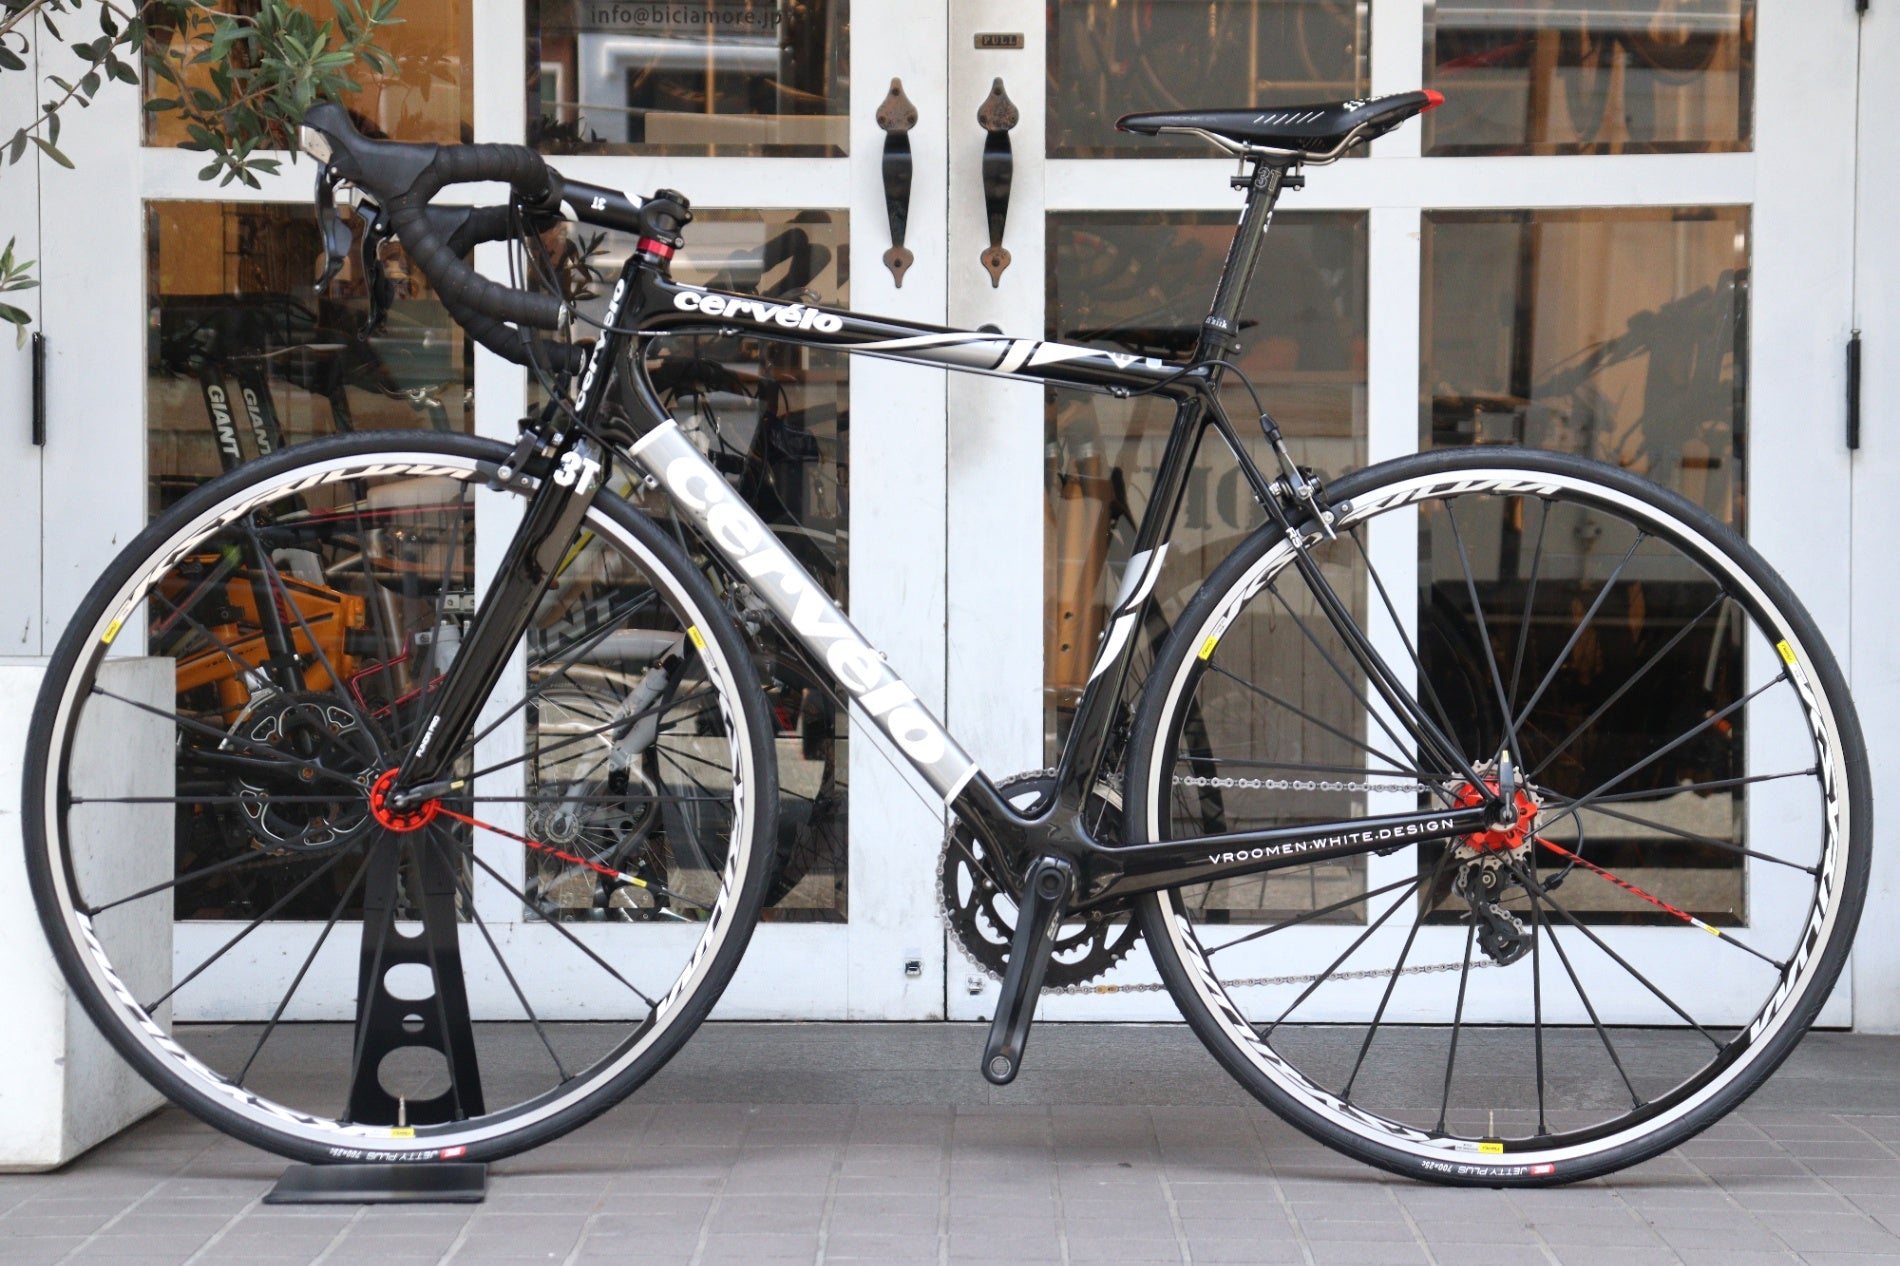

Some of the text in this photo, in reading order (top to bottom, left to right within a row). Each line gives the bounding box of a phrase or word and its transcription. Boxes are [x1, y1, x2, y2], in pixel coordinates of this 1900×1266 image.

[591, 6, 783, 28] info@biciamore.jp
[983, 35, 1017, 46] PULL
[673, 290, 843, 333] cervélo
[207, 384, 241, 459] GIANT
[553, 451, 602, 496] 3T
[1457, 1165, 1489, 1176] PLUS
[1490, 1166, 1528, 1177] JETTY
